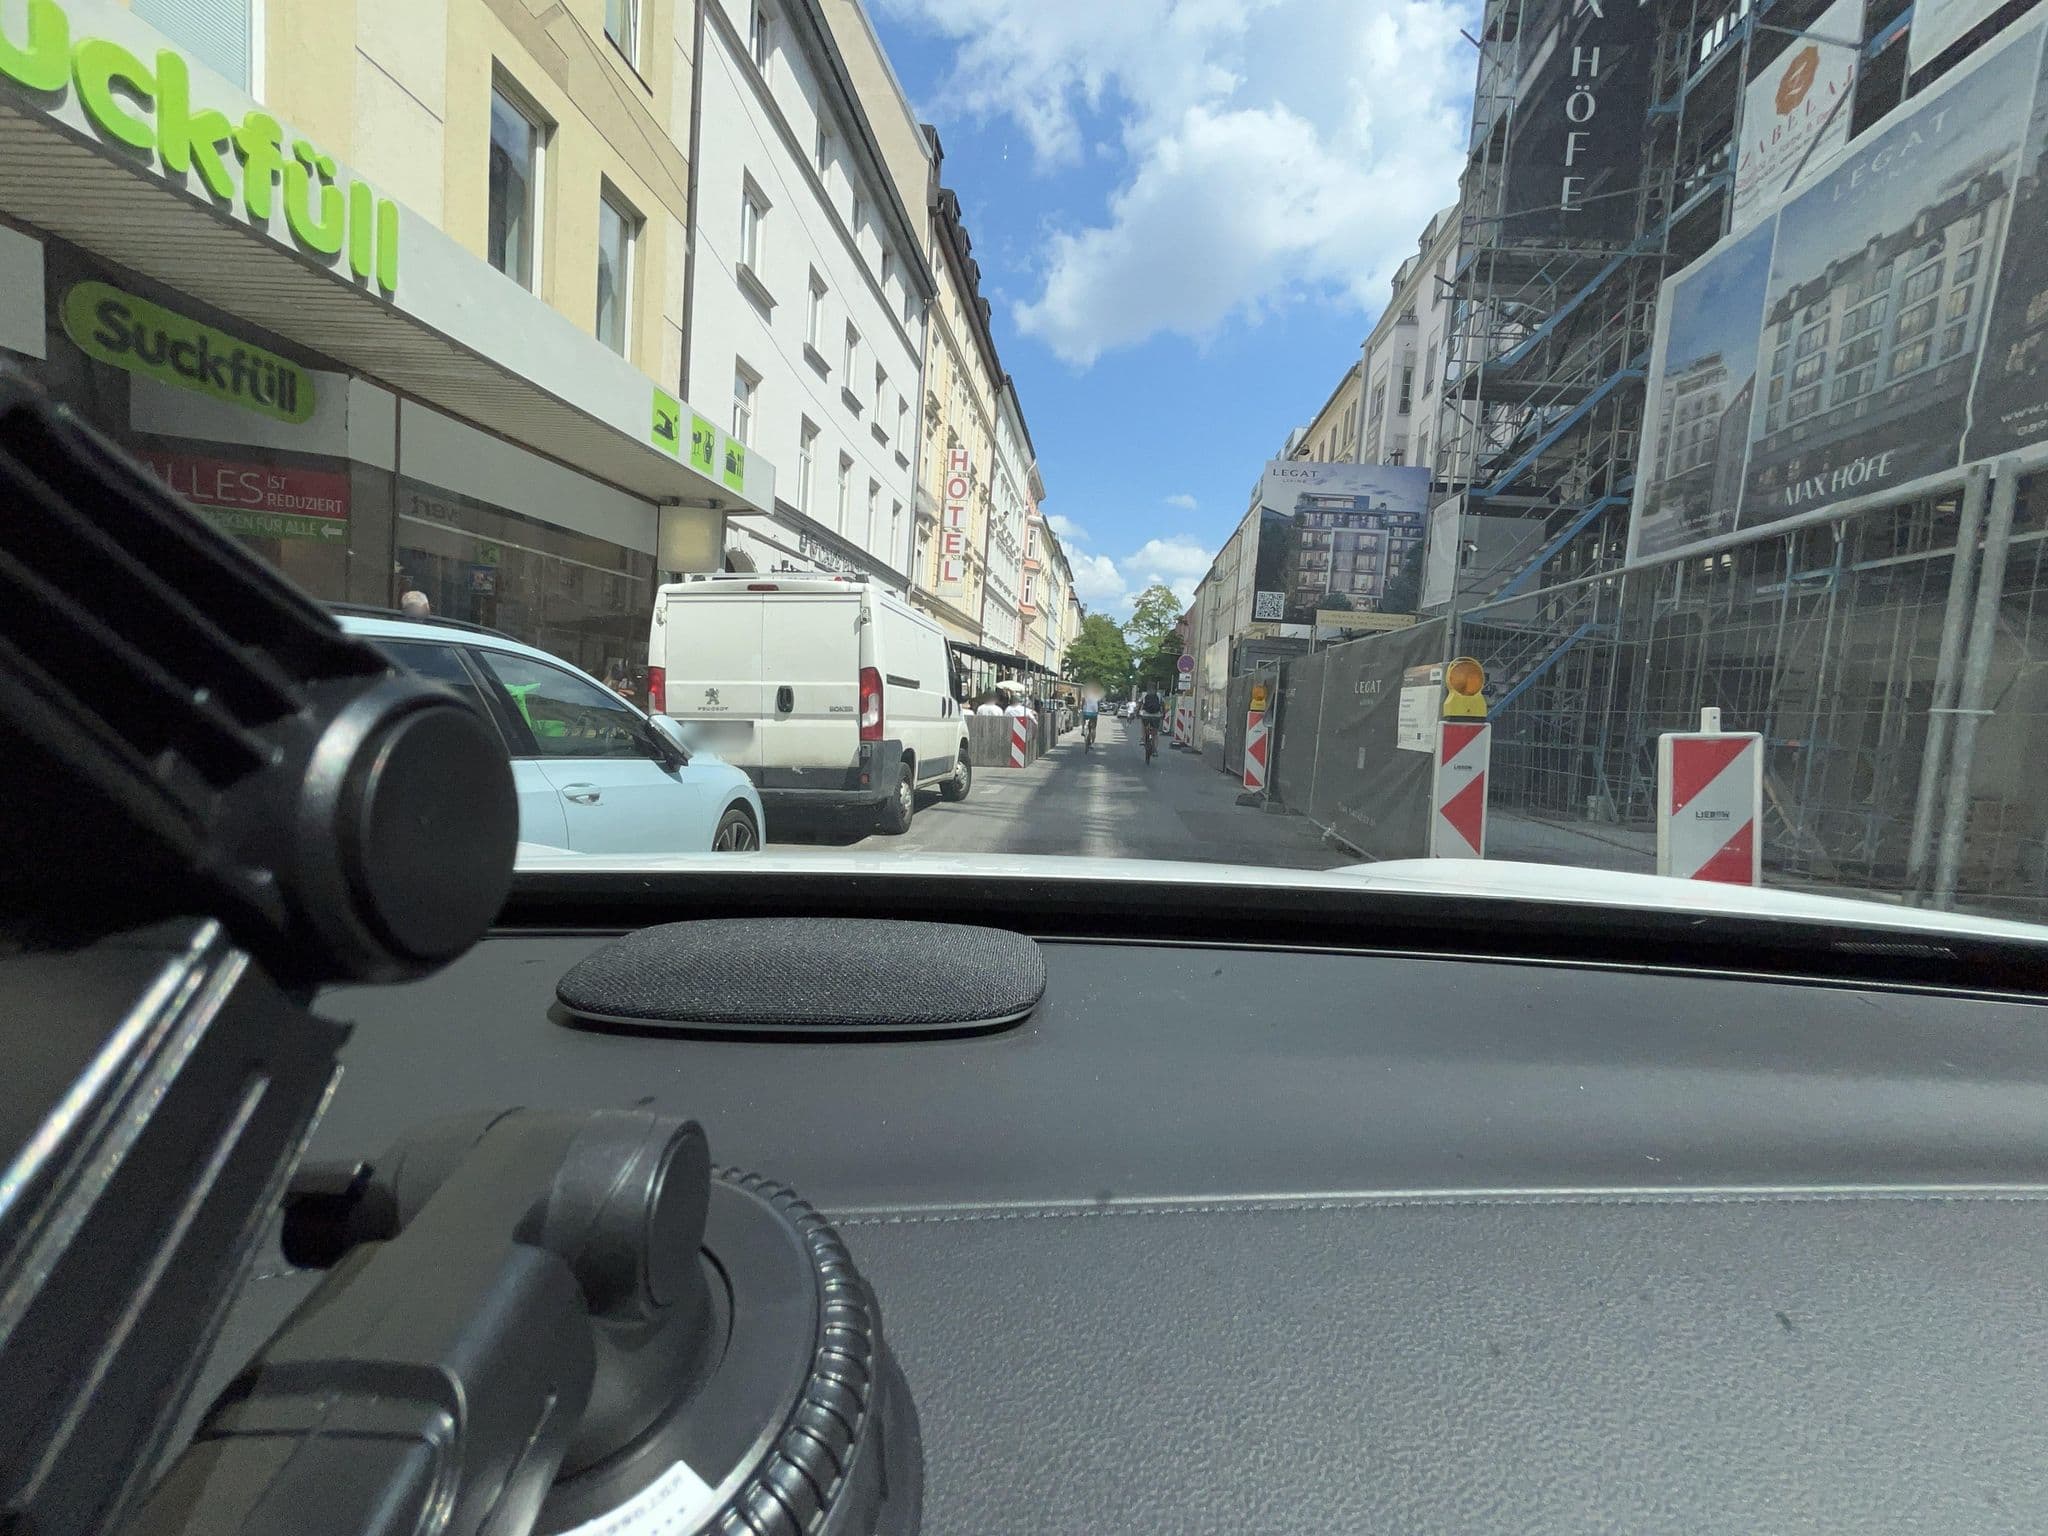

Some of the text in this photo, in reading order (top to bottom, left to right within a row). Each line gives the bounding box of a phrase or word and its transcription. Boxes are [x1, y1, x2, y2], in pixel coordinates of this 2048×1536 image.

[1561, 46, 1600, 211] HÖFE
[1833, 107, 1950, 201] LEGAT
[93, 301, 297, 414] Suckfüll
[268, 474, 287, 490] IST
[1273, 468, 1320, 478] LEGAT
[1784, 449, 1896, 506] MAX HÖFE
[267, 493, 343, 513] REDUZIERT
[944, 450, 968, 581] HOTEL
[1354, 679, 1382, 694] LEGAT
